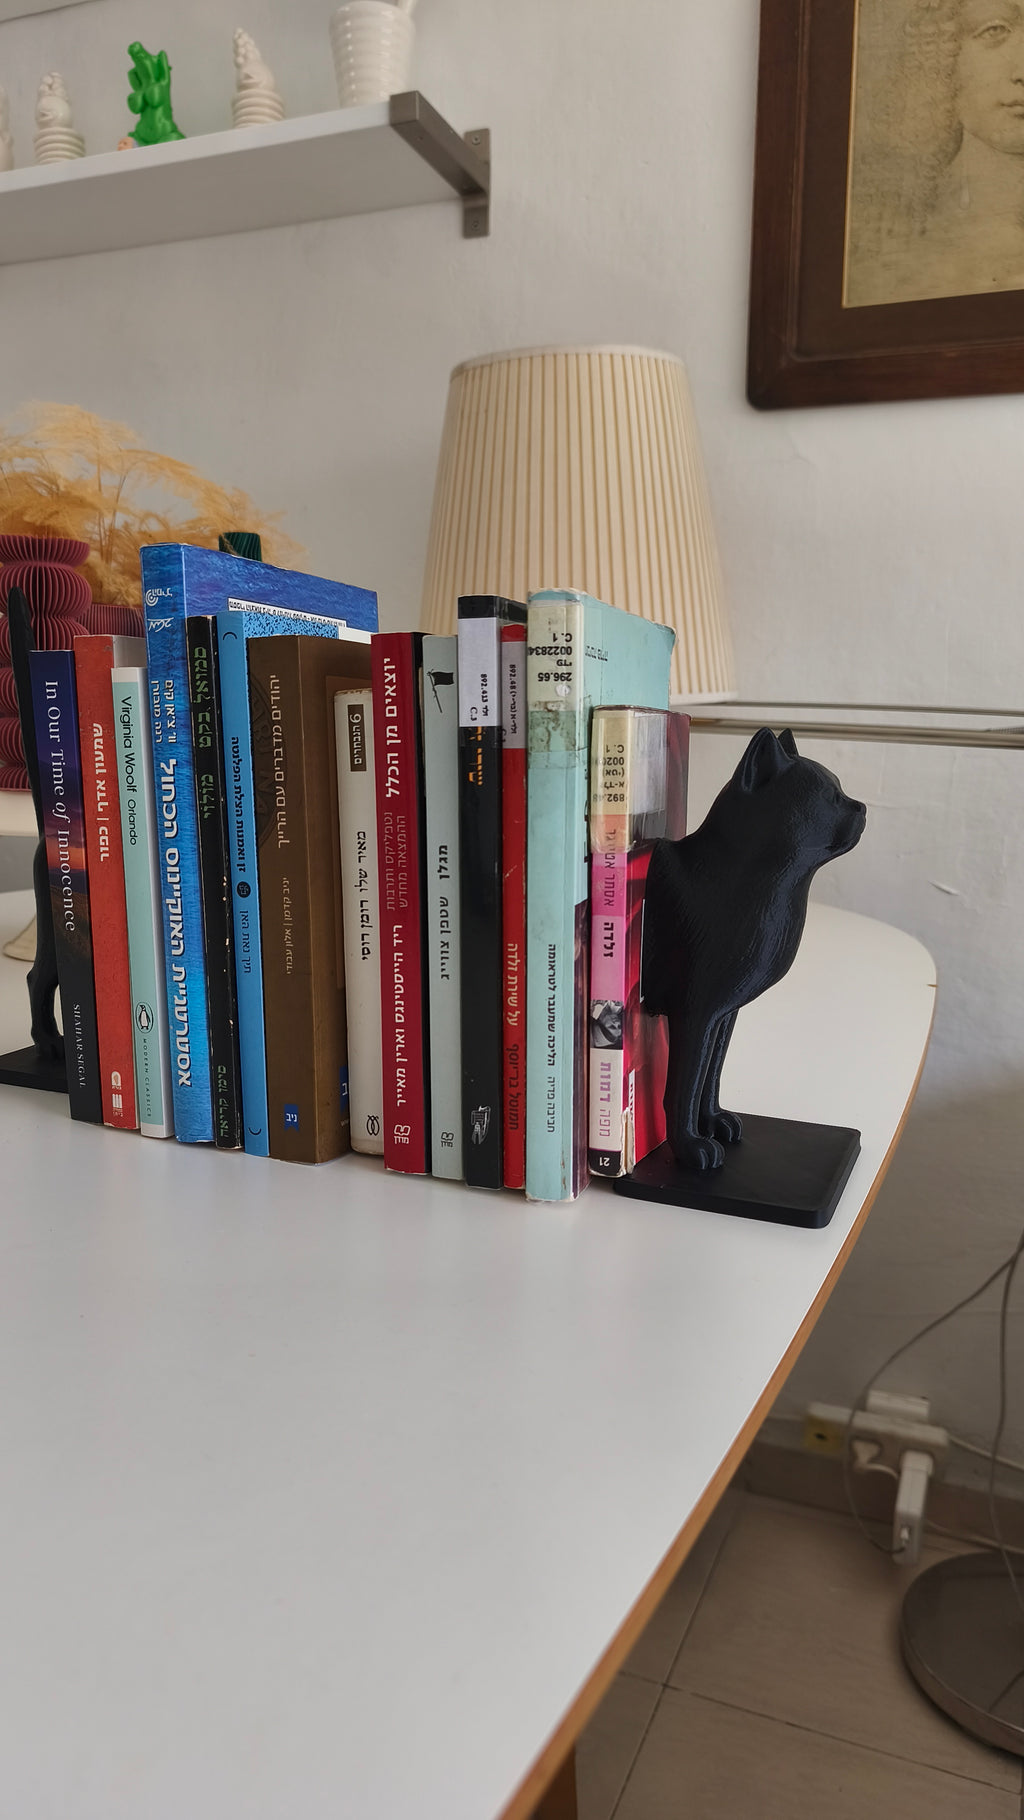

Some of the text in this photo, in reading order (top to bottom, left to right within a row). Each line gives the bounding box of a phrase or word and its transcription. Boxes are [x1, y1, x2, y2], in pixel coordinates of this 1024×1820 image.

[193, 646, 211, 704] סמואל
[528, 646, 573, 656] 0022834
[537, 672, 573, 682] 296.65
[151, 680, 163, 743] רנה מובורן
[164, 680, 175, 700] קים
[197, 711, 213, 749] בקט
[349, 713, 363, 765] 6 הנבחרים
[383, 657, 401, 798] יוצאים מן הכלל
[120, 696, 138, 846] Virginia Woolf Orlando
[231, 736, 243, 782] הפלנטה
[269, 674, 290, 849] יהודים מדברים עם הרייך
[468, 748, 483, 785] שירי
[45, 681, 76, 932] In Our Time of Innocence
[93, 722, 109, 862] שמעון אדף כפור
[234, 785, 245, 817] הצלת
[235, 820, 247, 861] ואמנות
[236, 863, 247, 873] זן
[383, 811, 396, 911] נטפליקס ותרבות
[396, 815, 409, 908] ההמצאה מחדש
[354, 831, 373, 961] מאיר שלו רומן רוסי
[437, 845, 451, 980] מגלן שטפן צווייג
[604, 873, 615, 907] אסתר
[160, 758, 192, 1088] אסטרטגיית האוקיינוס הכחול
[239, 910, 250, 929] האן
[241, 932, 251, 953] נאת
[282, 877, 294, 975] יניב קדמן אלון עבודי
[604, 921, 616, 958] זלדה
[241, 956, 252, 974] תיך
[507, 943, 520, 1026] על שירת זלדה
[392, 925, 408, 1107] ריד הייסטינגס וארין מאייר
[547, 943, 558, 1067] הליכה שמעבר לטראומה
[73, 1003, 87, 1089] SHAHAR SEGAL
[217, 1065, 229, 1138] סימן קריאה
[286, 1113, 298, 1122] ניב
[508, 1093, 521, 1131] חמוטל
[546, 1076, 556, 1133] חביבה פדיה
[599, 1062, 611, 1137] מפה דמות
[599, 1156, 610, 1167] 21
